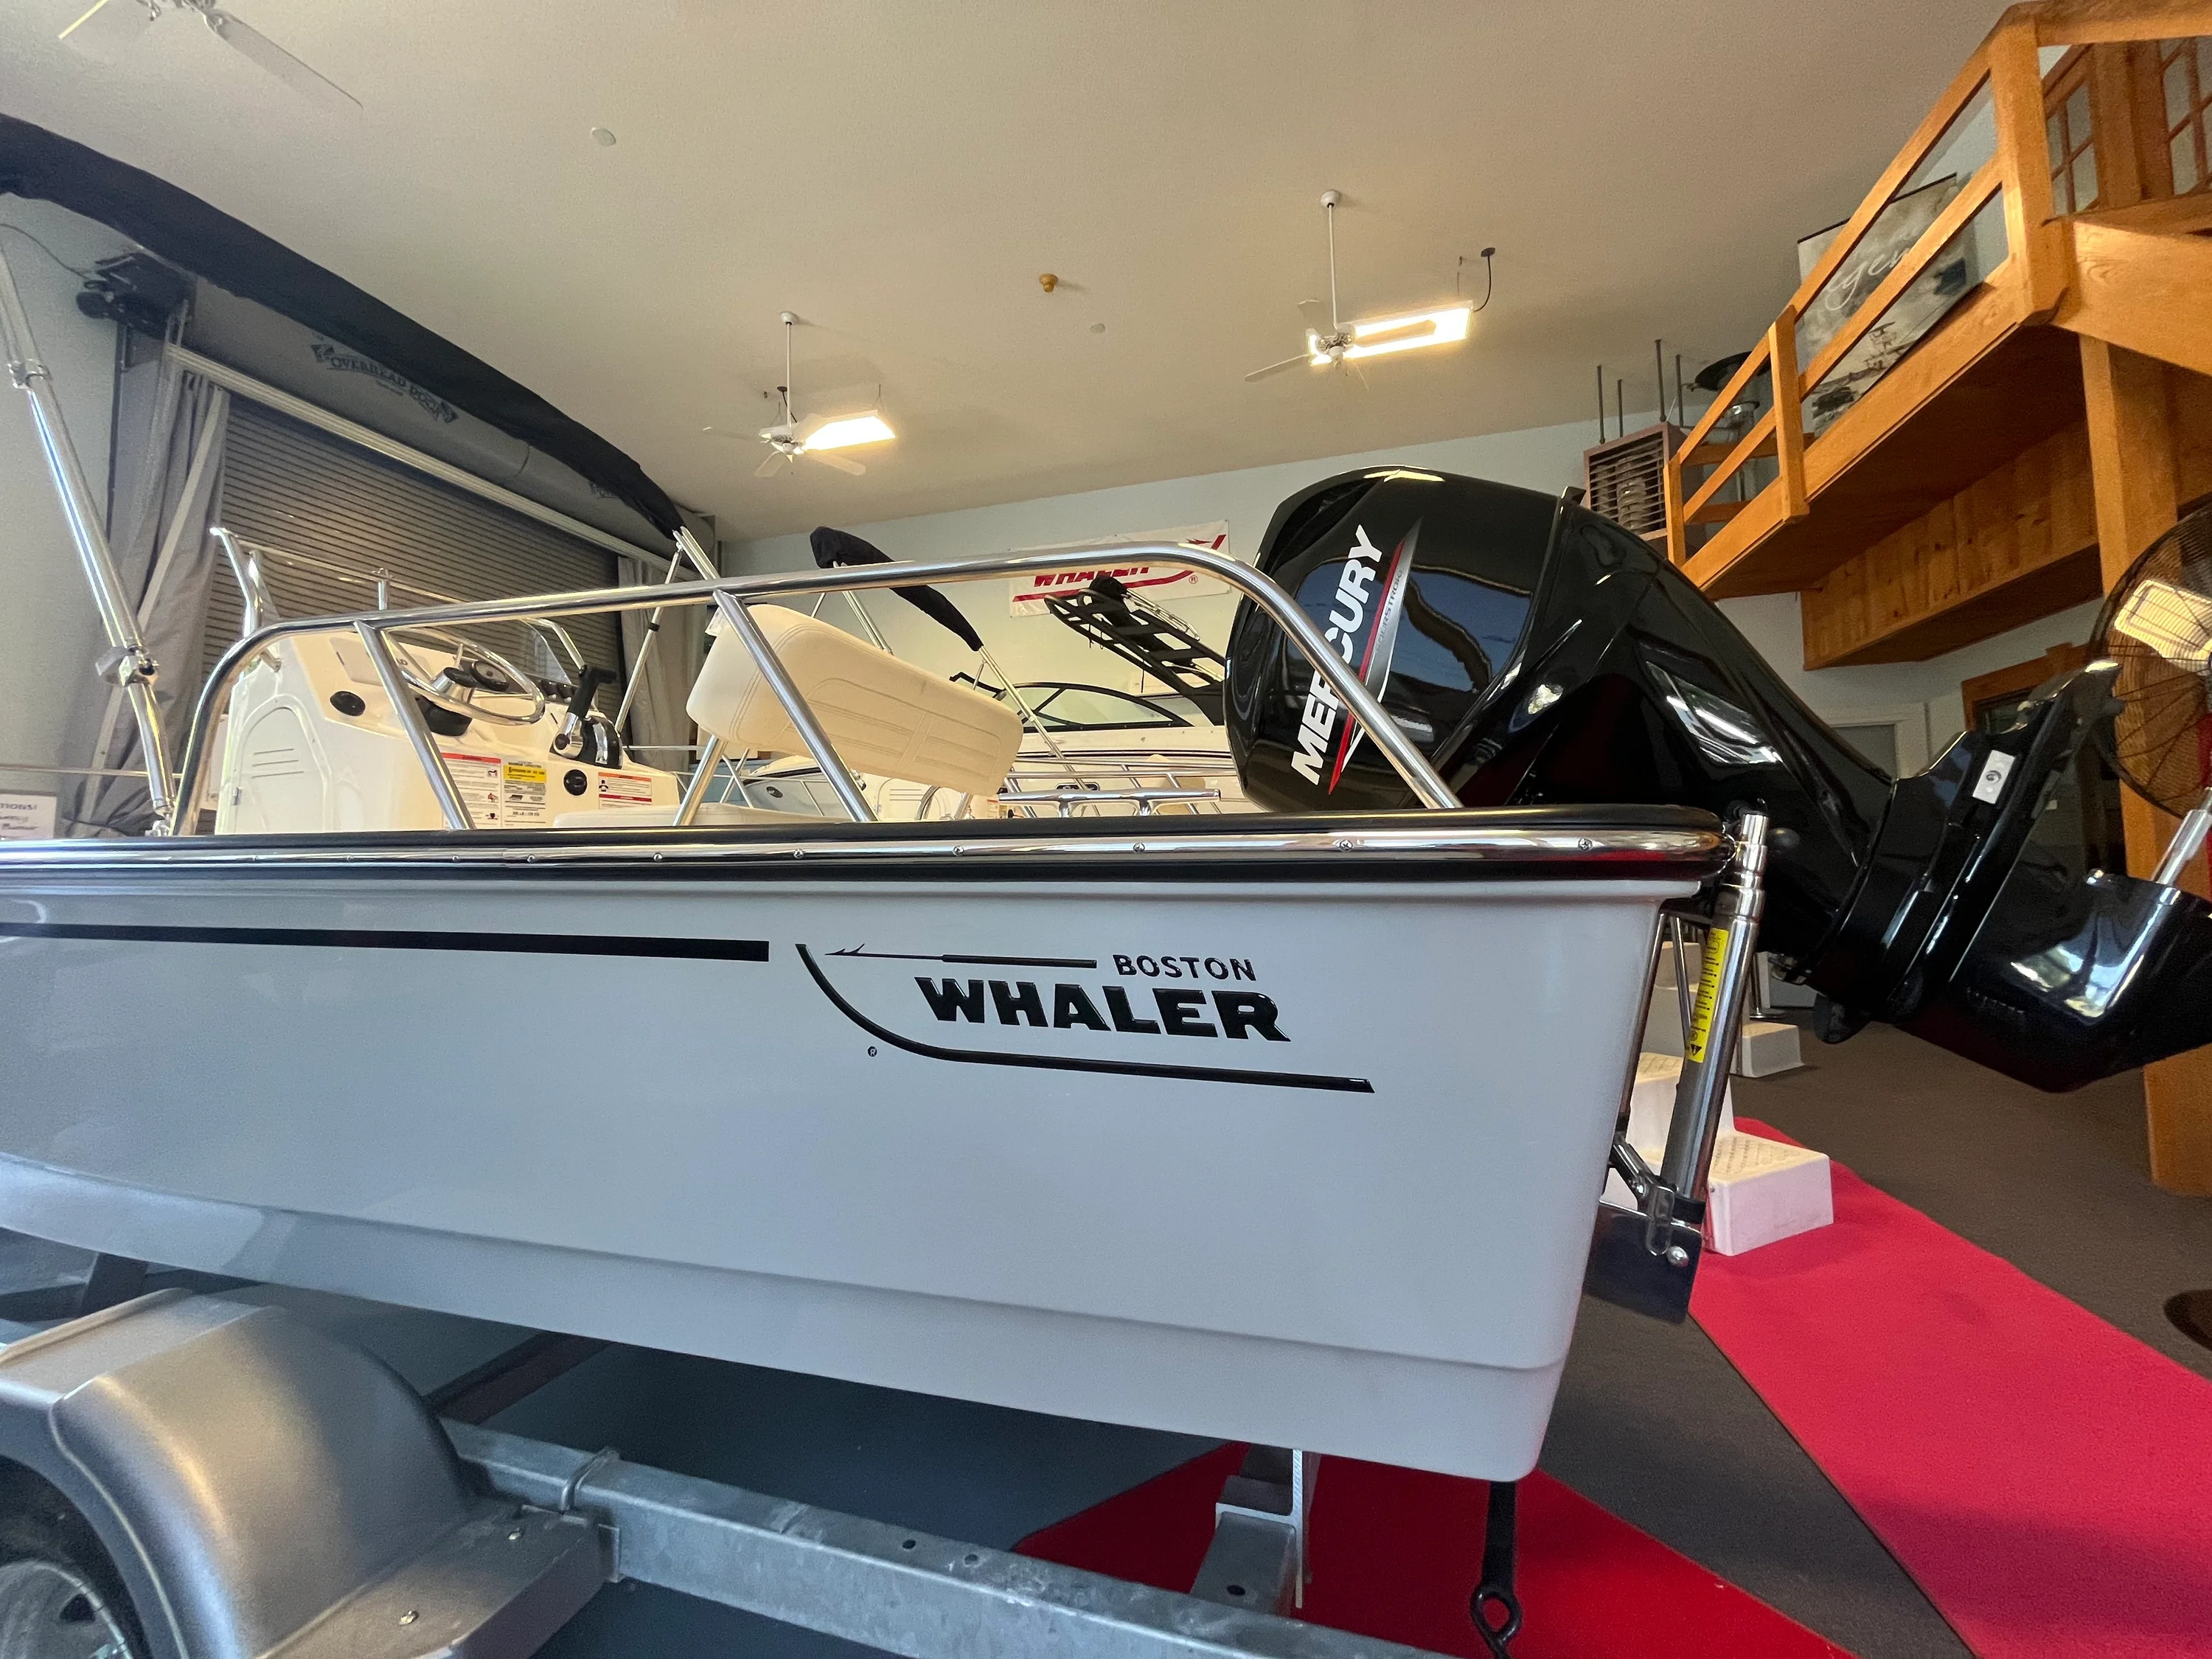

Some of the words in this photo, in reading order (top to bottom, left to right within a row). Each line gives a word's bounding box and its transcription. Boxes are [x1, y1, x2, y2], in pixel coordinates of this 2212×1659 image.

[1291, 524, 1382, 786] MERCURY
[1113, 954, 1257, 981] BOSTON
[914, 977, 1291, 1042] WHALER
